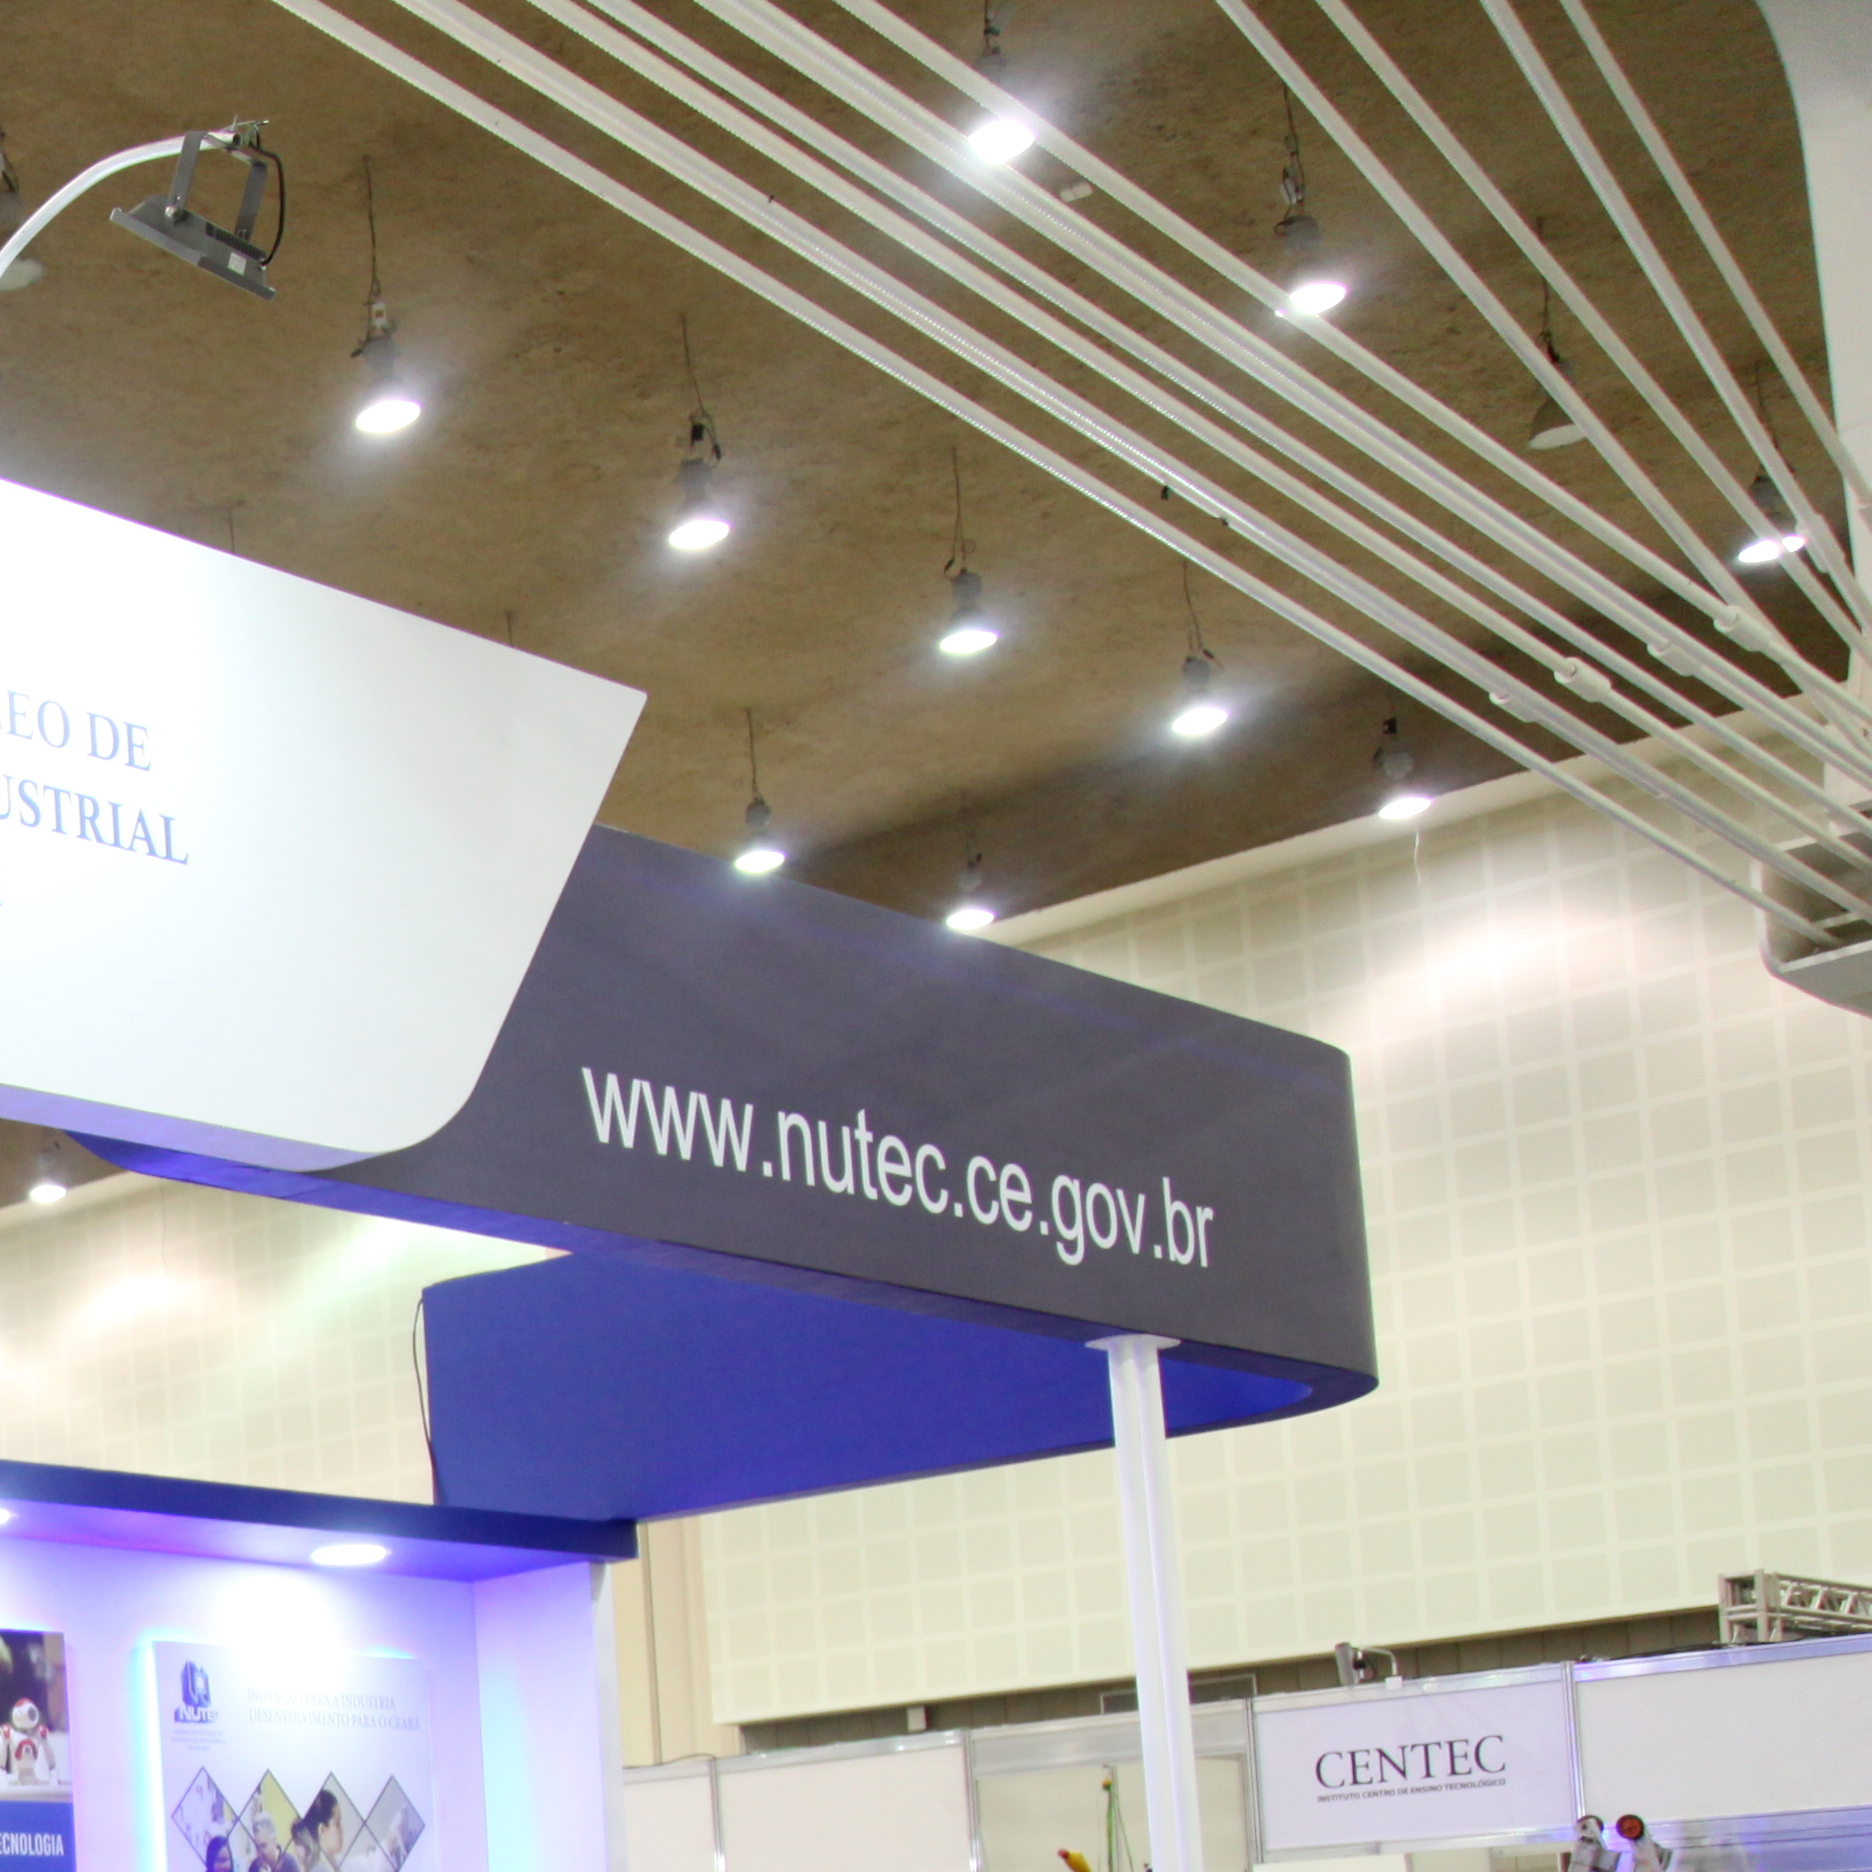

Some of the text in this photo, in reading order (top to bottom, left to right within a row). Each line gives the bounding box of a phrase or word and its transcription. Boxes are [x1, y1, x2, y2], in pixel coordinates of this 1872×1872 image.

[85, 711, 152, 772] DE
[581, 1067, 1214, 1267] www.nutec.ce.gov.br
[1315, 1735, 1506, 1789] CENTEC
[1317, 1778, 1506, 1803] INSTITUTO CENTRO DE ENSINO TECNOLÓGICO
